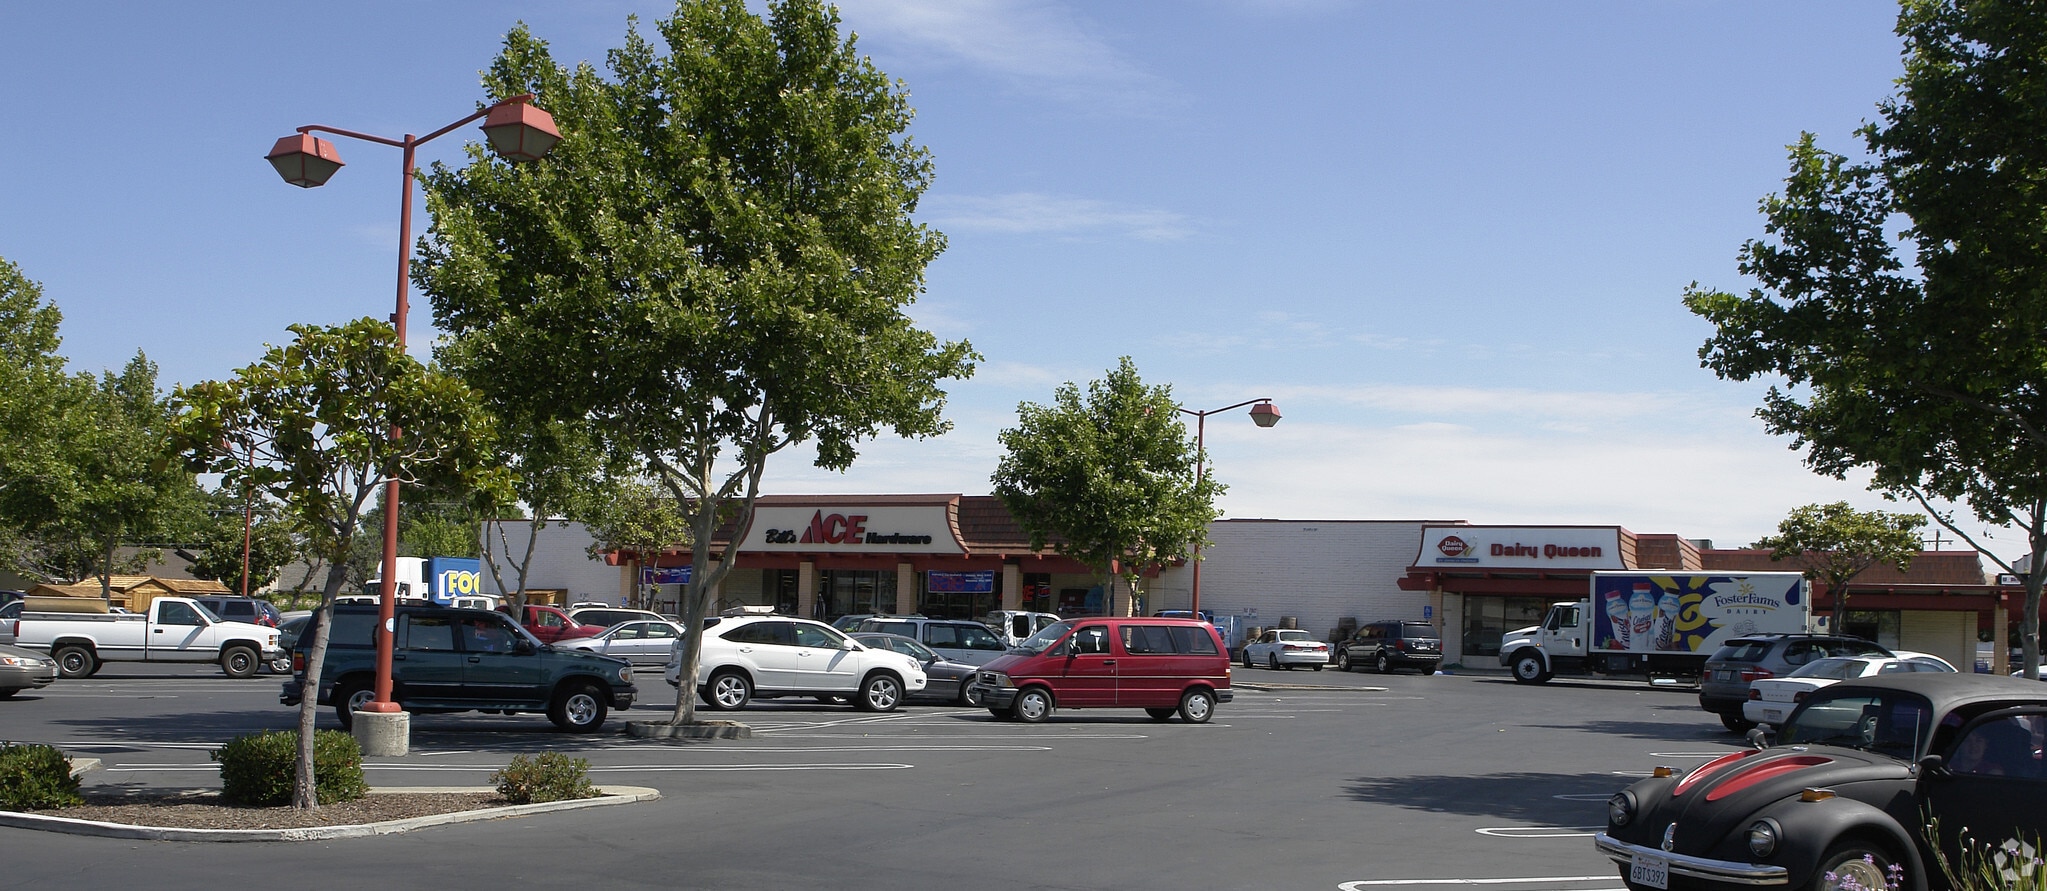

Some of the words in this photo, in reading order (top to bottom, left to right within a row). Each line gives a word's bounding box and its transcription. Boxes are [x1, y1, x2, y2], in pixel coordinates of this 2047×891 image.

[765, 529, 797, 544] Bill's
[799, 509, 868, 544] ACE
[865, 532, 932, 544] Hardware
[1490, 542, 1538, 559] Dairy
[1544, 544, 1602, 560] Queen
[1633, 866, 1665, 884] 6BTS392
